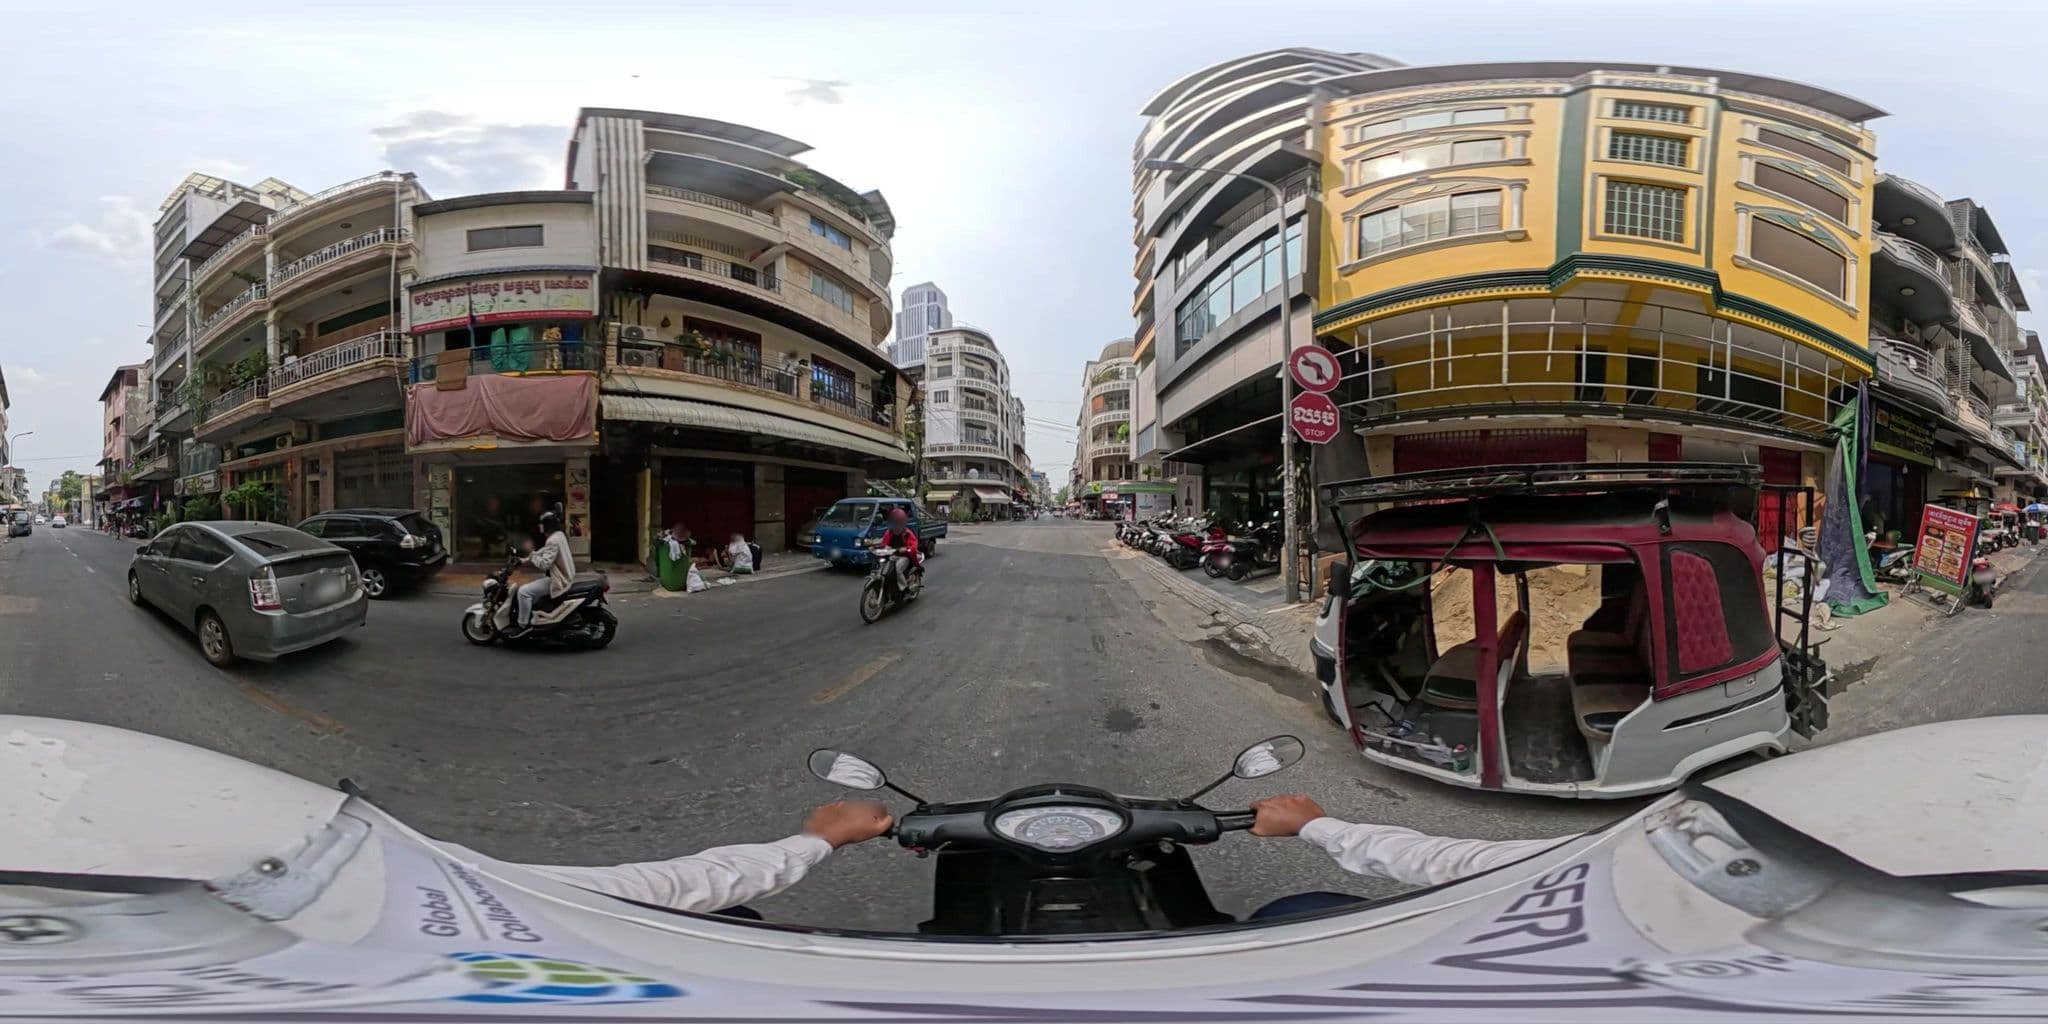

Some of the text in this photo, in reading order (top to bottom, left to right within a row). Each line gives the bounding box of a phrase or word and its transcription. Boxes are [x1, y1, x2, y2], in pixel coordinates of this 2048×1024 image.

[1293, 404, 1335, 426] ឈប់
[1304, 428, 1326, 437] STOP
[416, 885, 461, 937] Global
